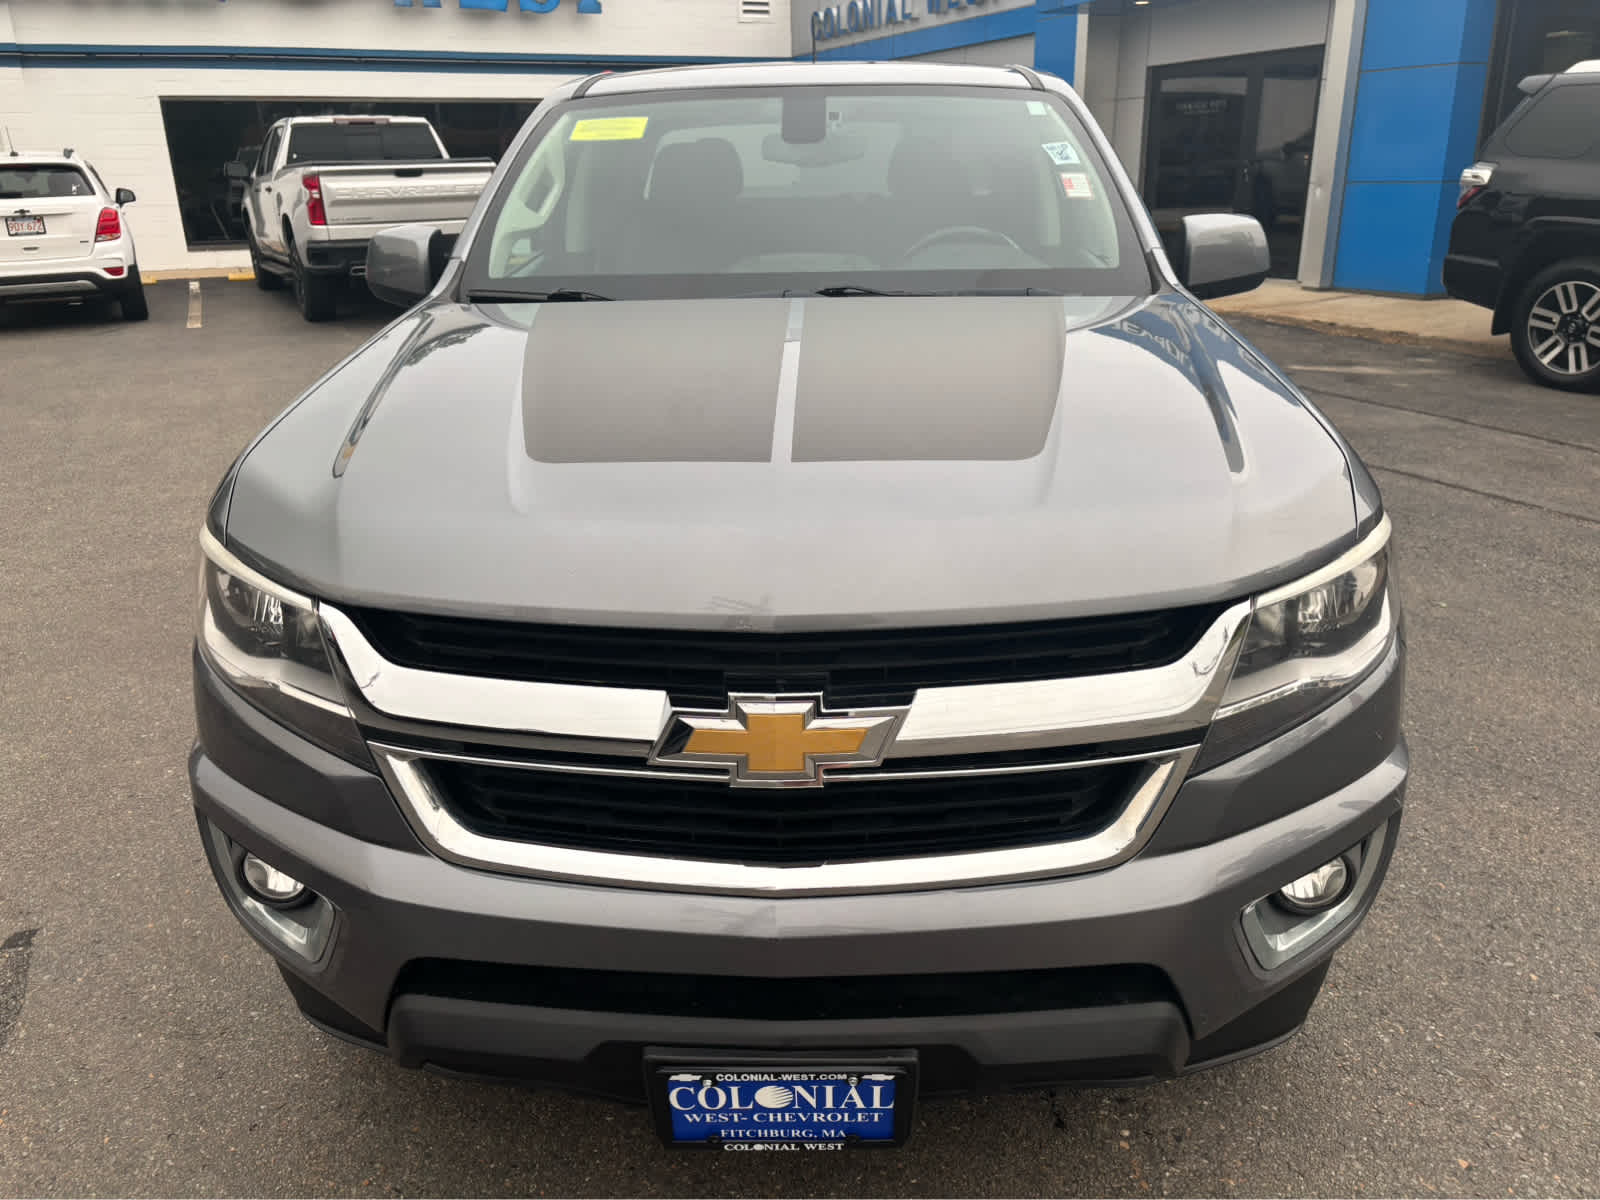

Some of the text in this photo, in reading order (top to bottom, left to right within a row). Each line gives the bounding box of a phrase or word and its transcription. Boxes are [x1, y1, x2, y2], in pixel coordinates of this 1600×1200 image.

[716, 1074, 847, 1082] COLONIAL-WEST.COM
[669, 1085, 894, 1110] COLONIAL
[753, 1112, 884, 1123] CHEVROLET
[822, 1129, 846, 1138] MA
[724, 1143, 845, 1151] COLONIAL WEST
